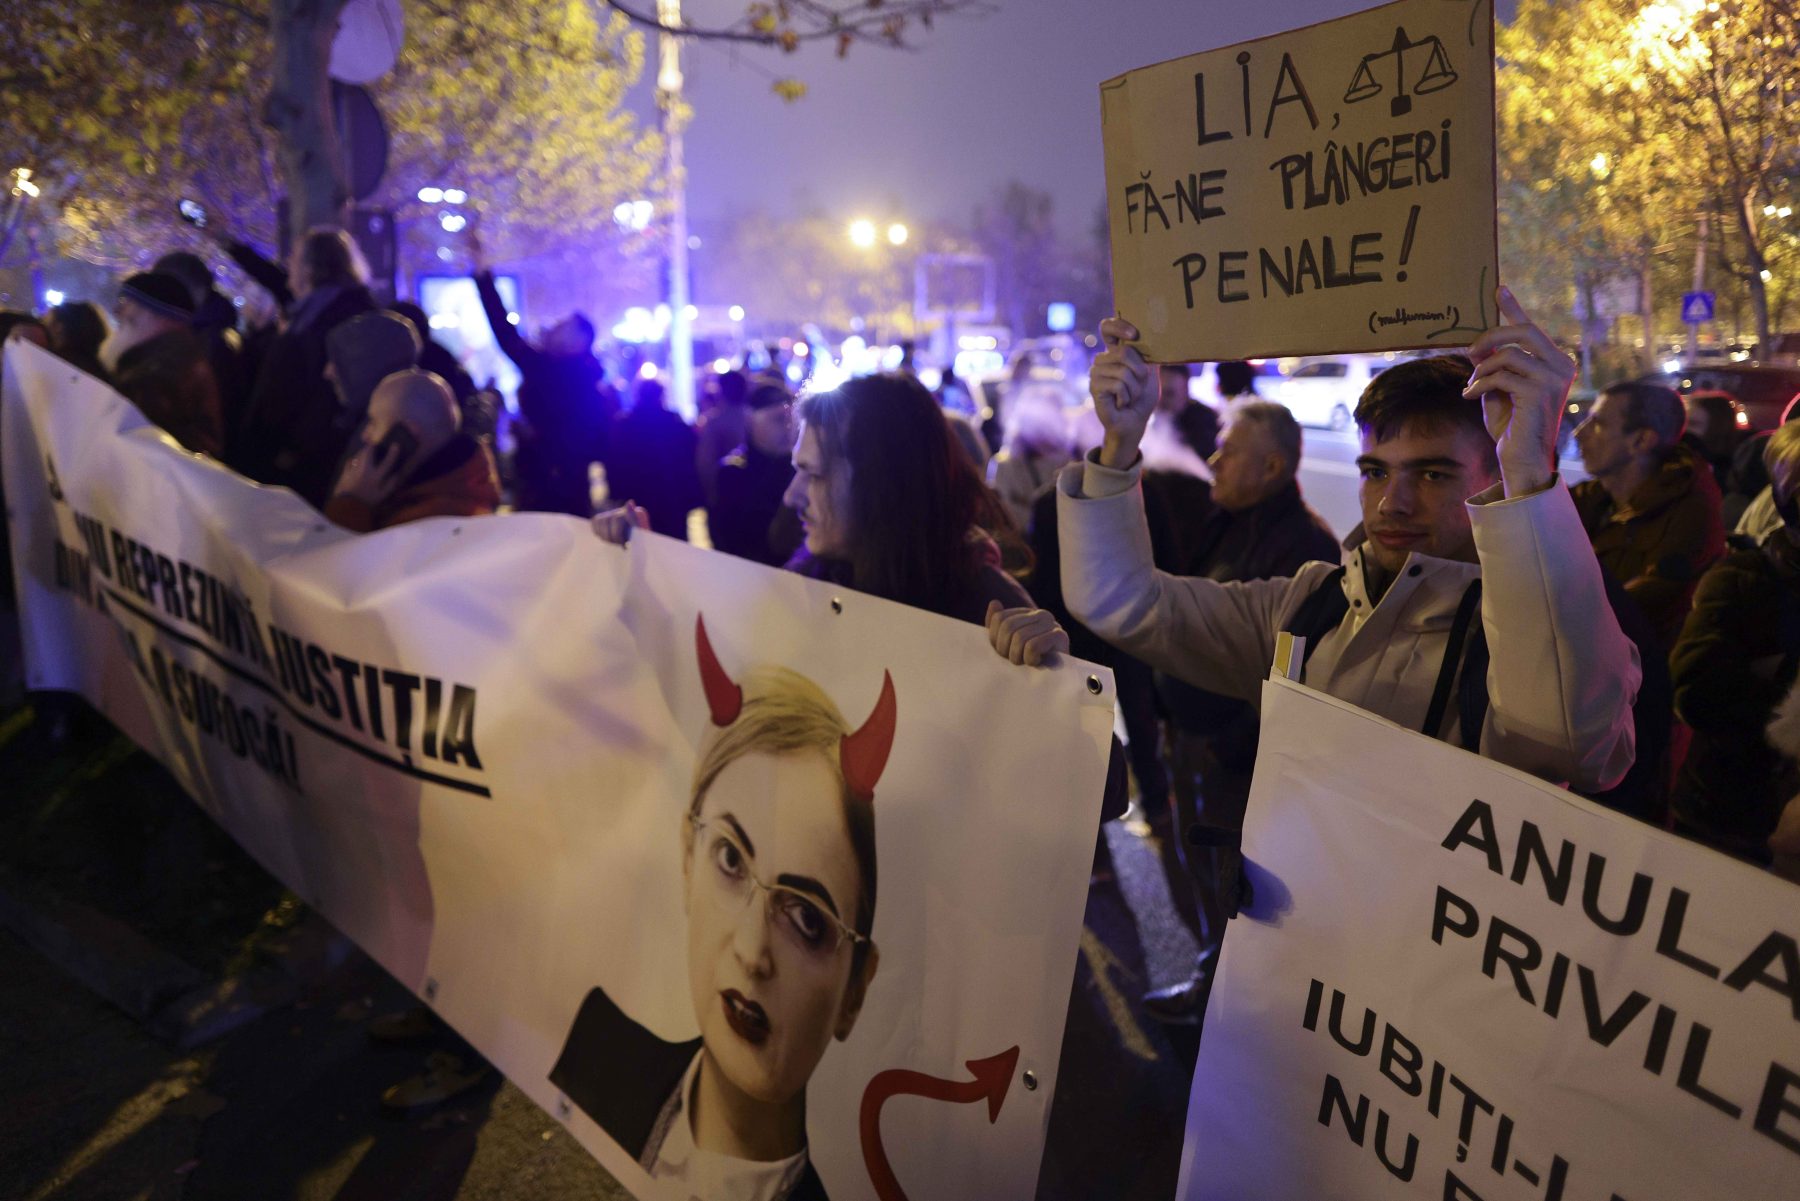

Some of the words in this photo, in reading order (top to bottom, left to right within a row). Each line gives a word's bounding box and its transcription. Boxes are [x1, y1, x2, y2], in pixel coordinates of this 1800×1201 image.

[1125, 170, 1228, 234] FĂ-NE
[1172, 205, 1422, 309] PENALE!
[268, 622, 484, 771] JUSTIȚIA
[1441, 798, 1800, 1022] ANULA
[1318, 1073, 1420, 1183] NU
